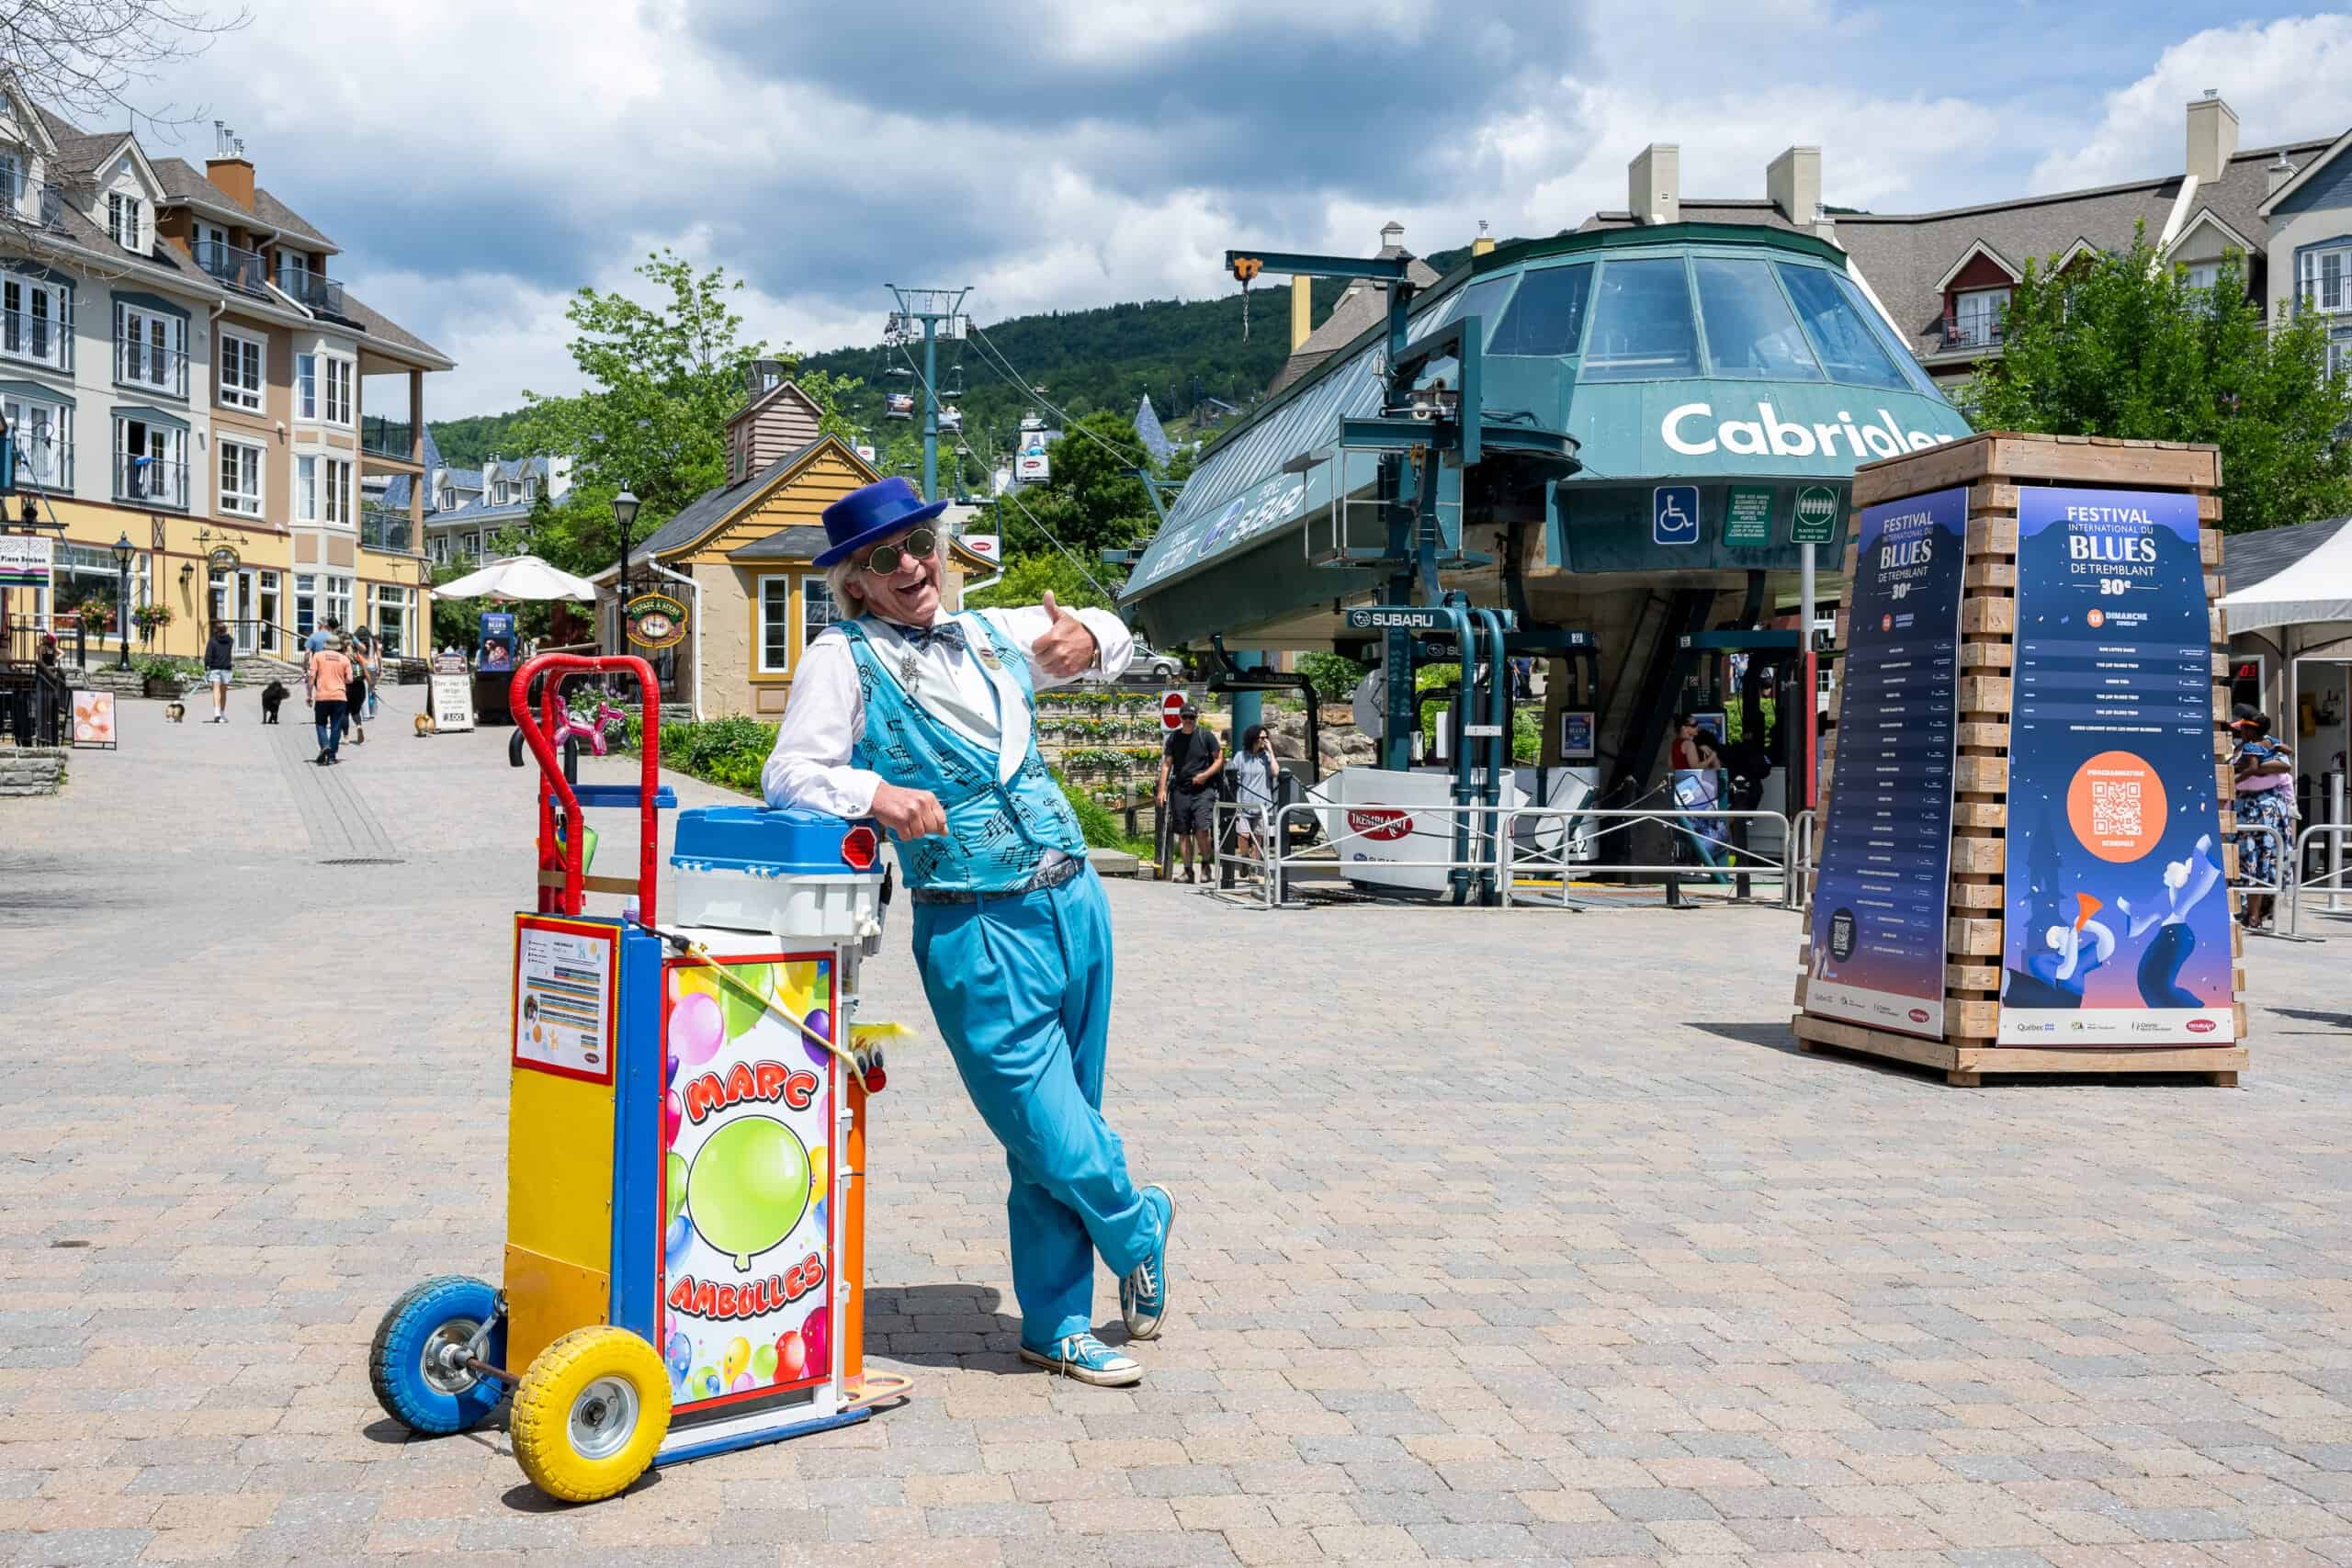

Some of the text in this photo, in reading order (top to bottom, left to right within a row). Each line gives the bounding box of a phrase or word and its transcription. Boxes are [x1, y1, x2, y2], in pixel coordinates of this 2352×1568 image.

[1883, 510, 1934, 534] FESTIVAL
[2067, 506, 2154, 525] FESTIVAL
[2068, 524, 2154, 535] INTERNATIONAL DU
[1881, 538, 1932, 570] BLUES
[2069, 535, 2157, 563] BLUES
[1888, 566, 1929, 581] TREMBLANT
[2071, 563, 2155, 577] DE TREMBLANT
[1373, 614, 1433, 627] SUBARU
[2105, 611, 2148, 621] DIMANCHE
[684, 1060, 819, 1126] MARC
[668, 1252, 826, 1321] AMBULLES
